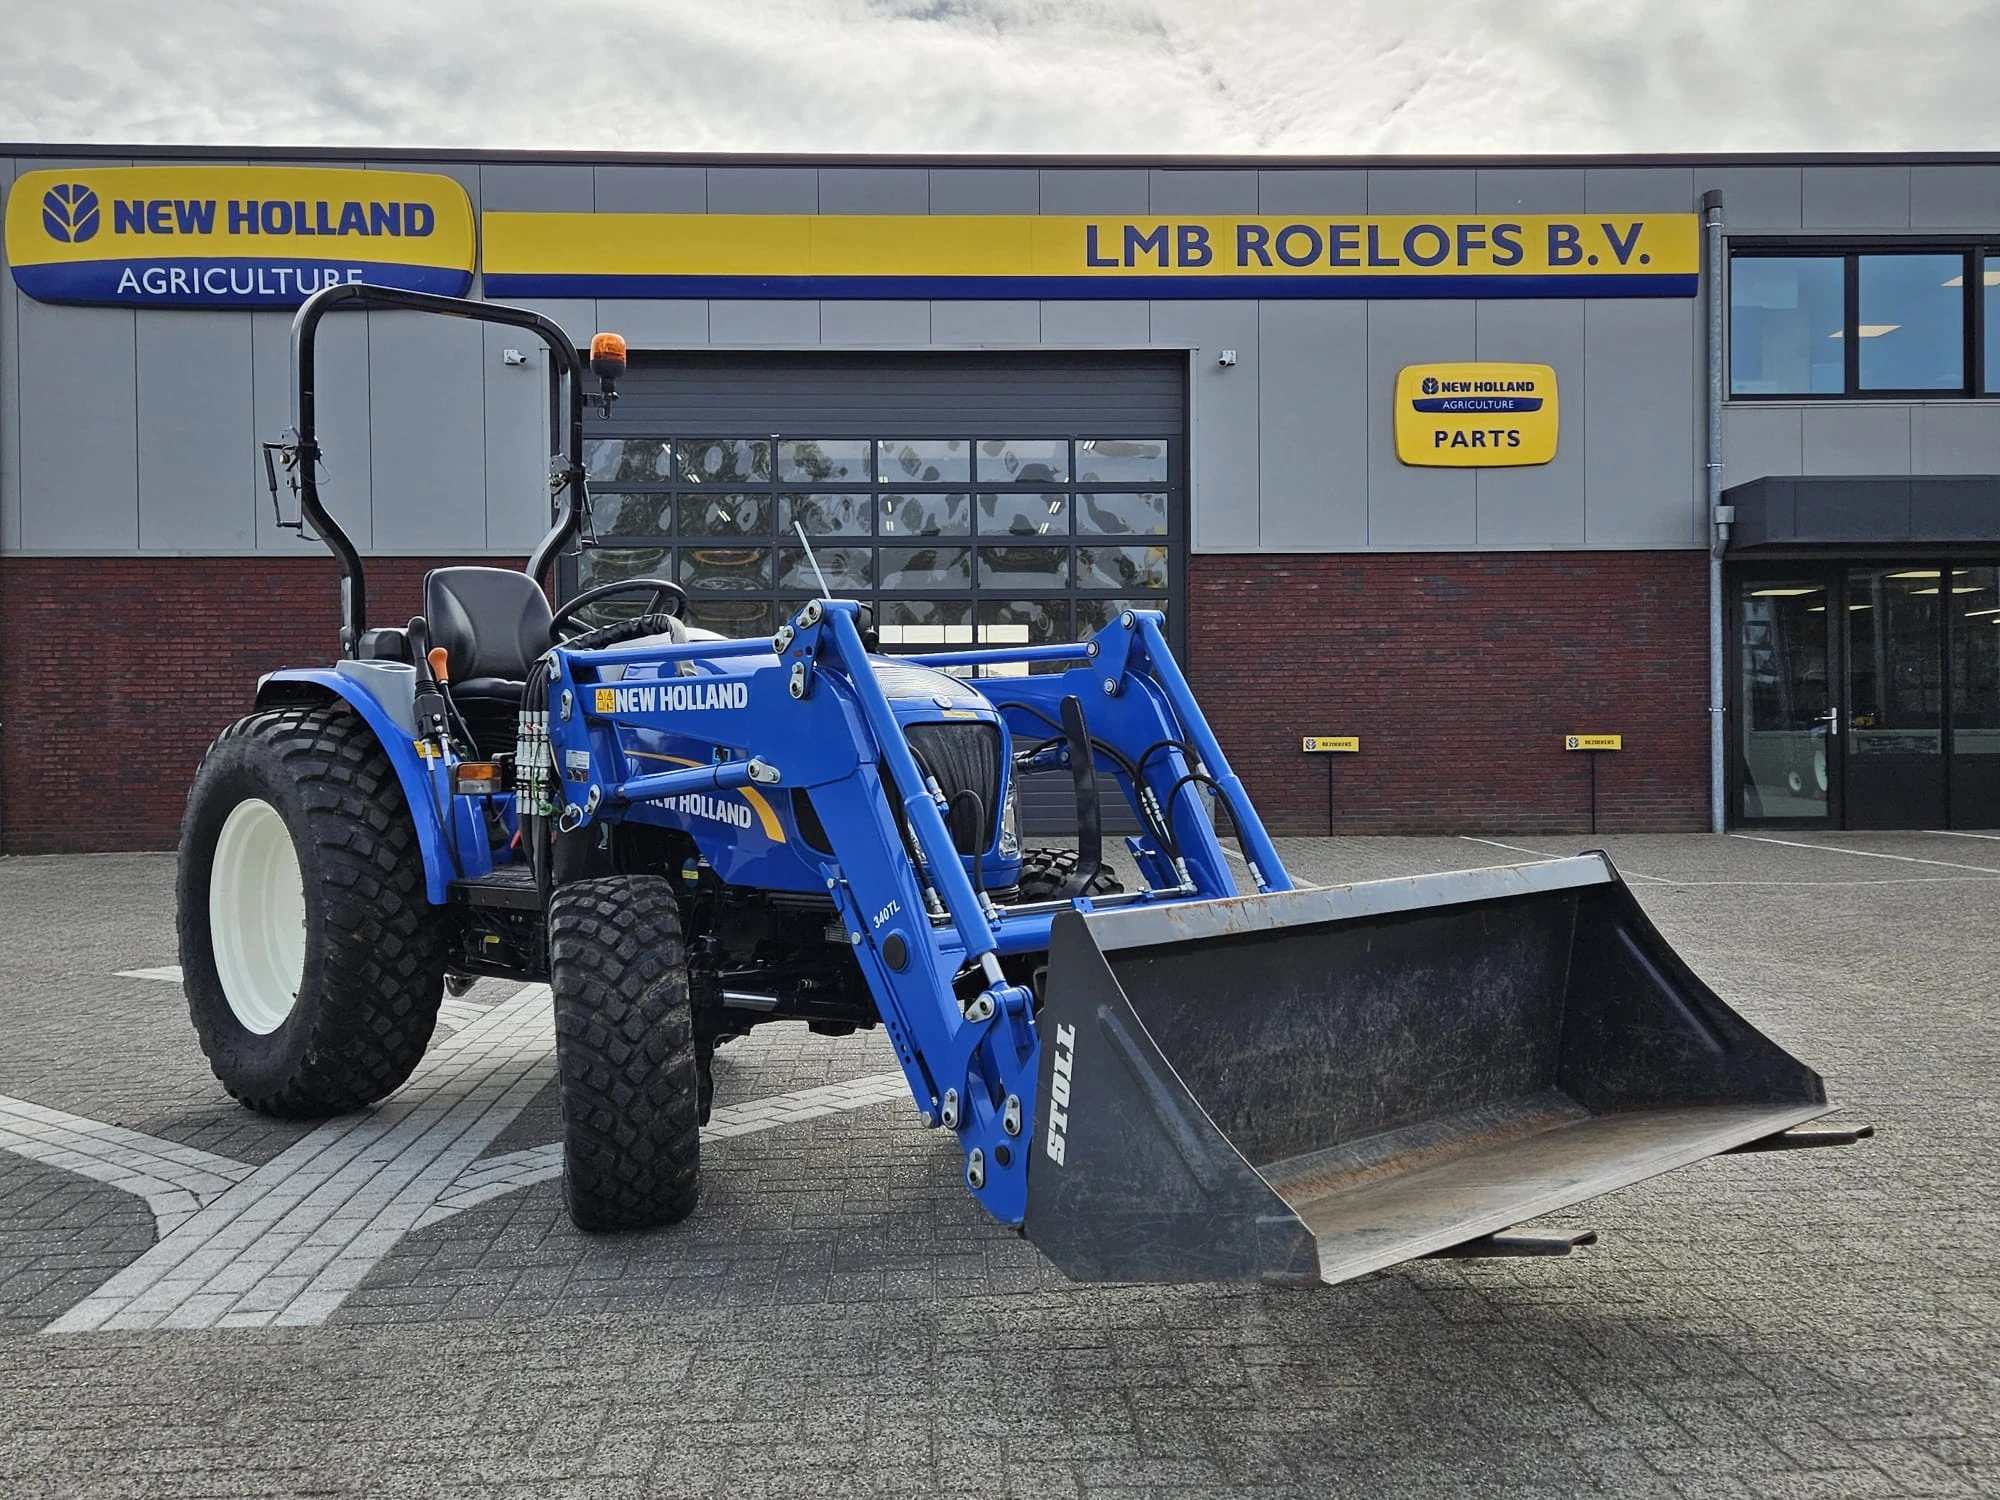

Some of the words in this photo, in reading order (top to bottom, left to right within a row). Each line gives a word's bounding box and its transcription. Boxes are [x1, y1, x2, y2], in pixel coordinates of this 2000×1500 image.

[114, 200, 216, 235] NEW
[228, 201, 435, 237] HOLLAND
[1086, 225, 1213, 268] LMB
[1237, 224, 1524, 268] ROELOFS
[1547, 222, 1651, 266] B.V.
[116, 267, 363, 295] AGRICULTURE
[1441, 382, 1471, 392] NEW
[1474, 381, 1535, 392] HOLLAND
[1443, 400, 1514, 409] AGRICULTURE
[1435, 430, 1521, 448] PARTS
[616, 687, 656, 713] NEW
[659, 683, 748, 712] HOLLAND
[680, 793, 751, 829] HOLLAND
[873, 899, 901, 929] 340TL
[1046, 1023, 1076, 1167] STOLL
